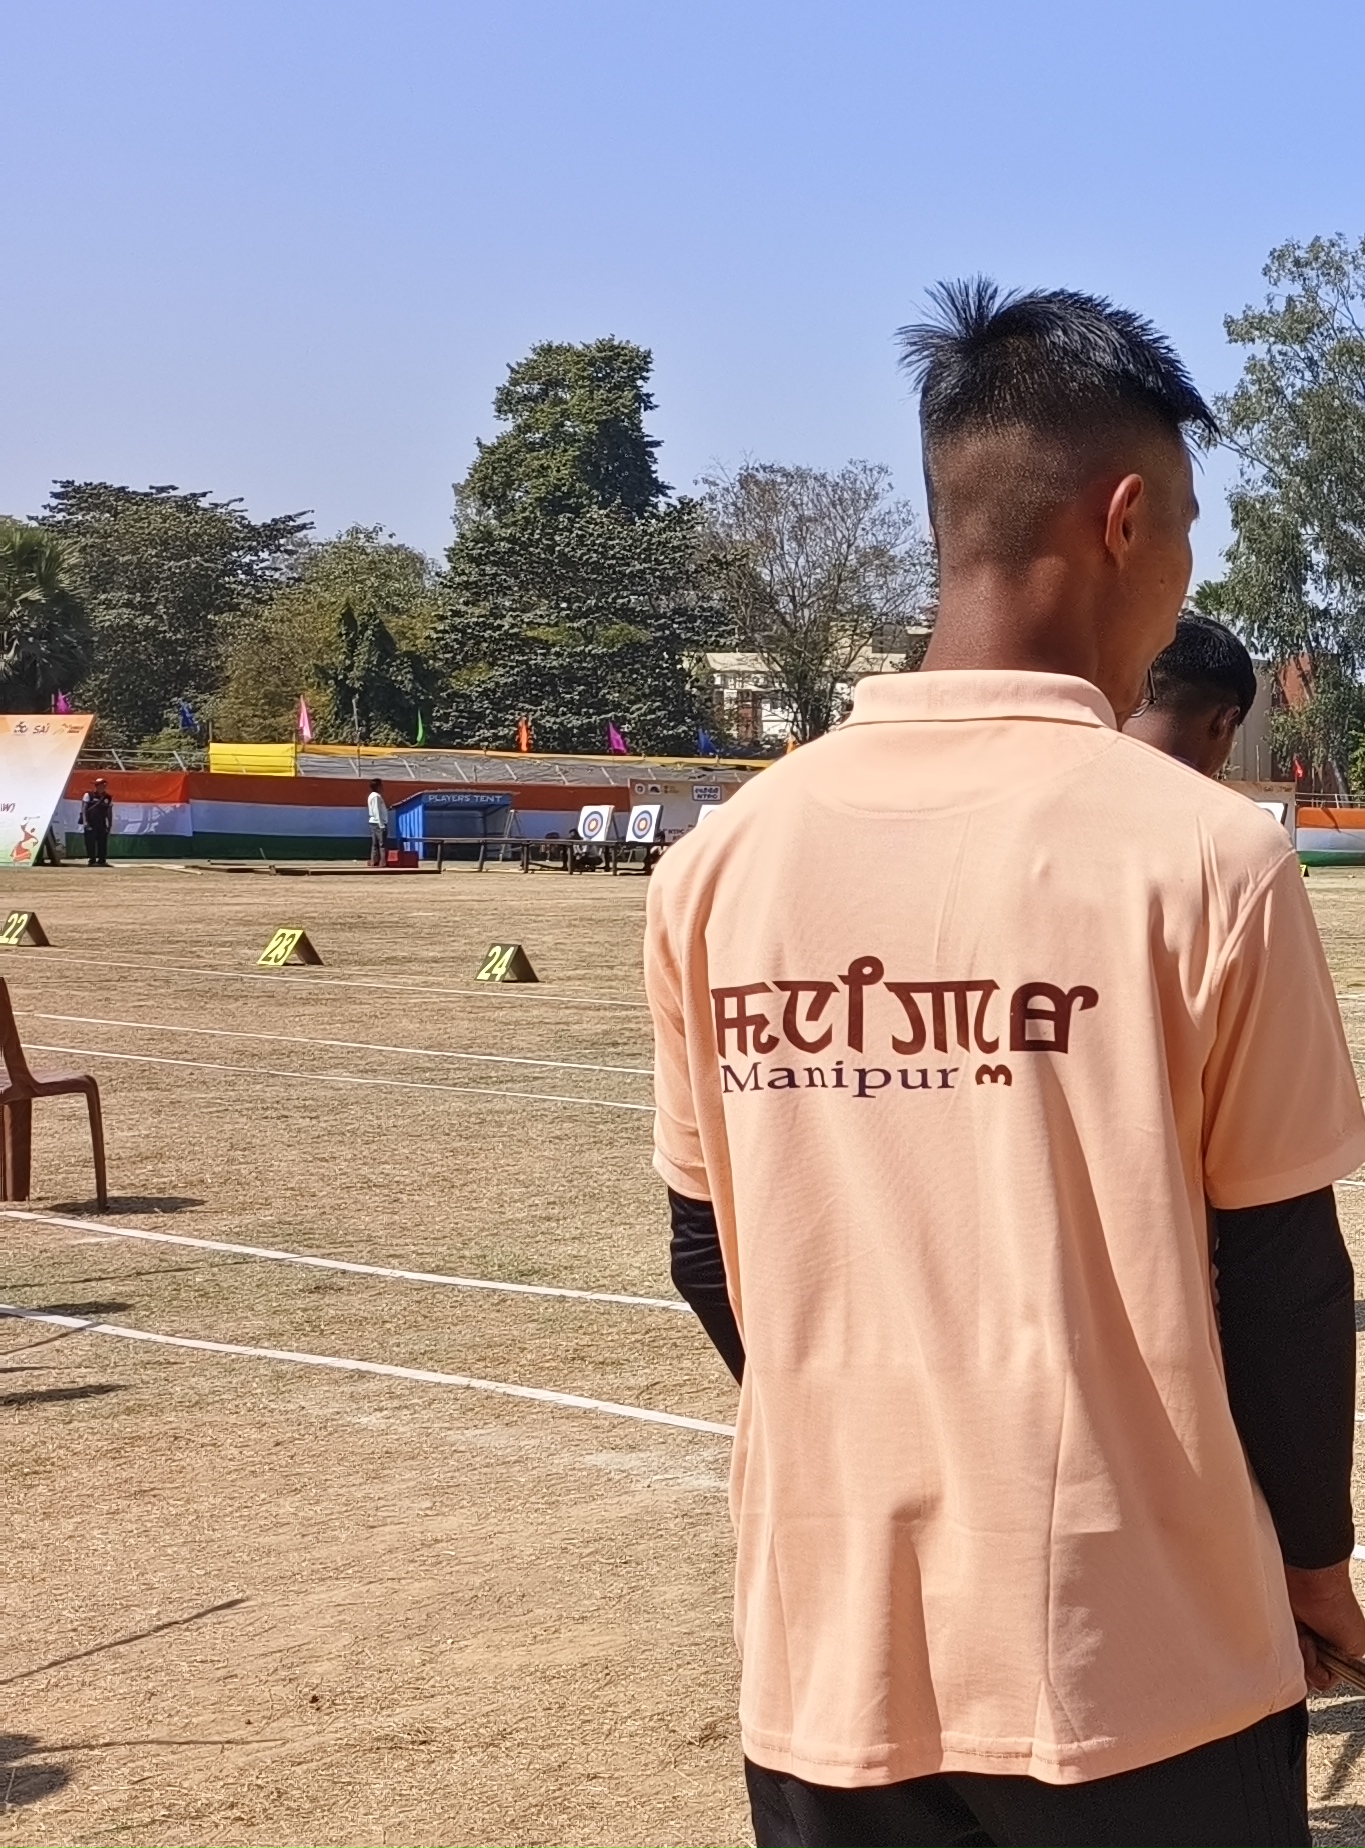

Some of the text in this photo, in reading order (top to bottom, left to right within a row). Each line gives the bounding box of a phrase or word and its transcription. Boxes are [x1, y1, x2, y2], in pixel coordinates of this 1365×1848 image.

[428, 794, 502, 803] PLAYERS TENT
[0, 912, 28, 944] 22
[263, 932, 297, 964] 23
[475, 945, 515, 982] 24
[720, 1060, 960, 1098] Manipur
